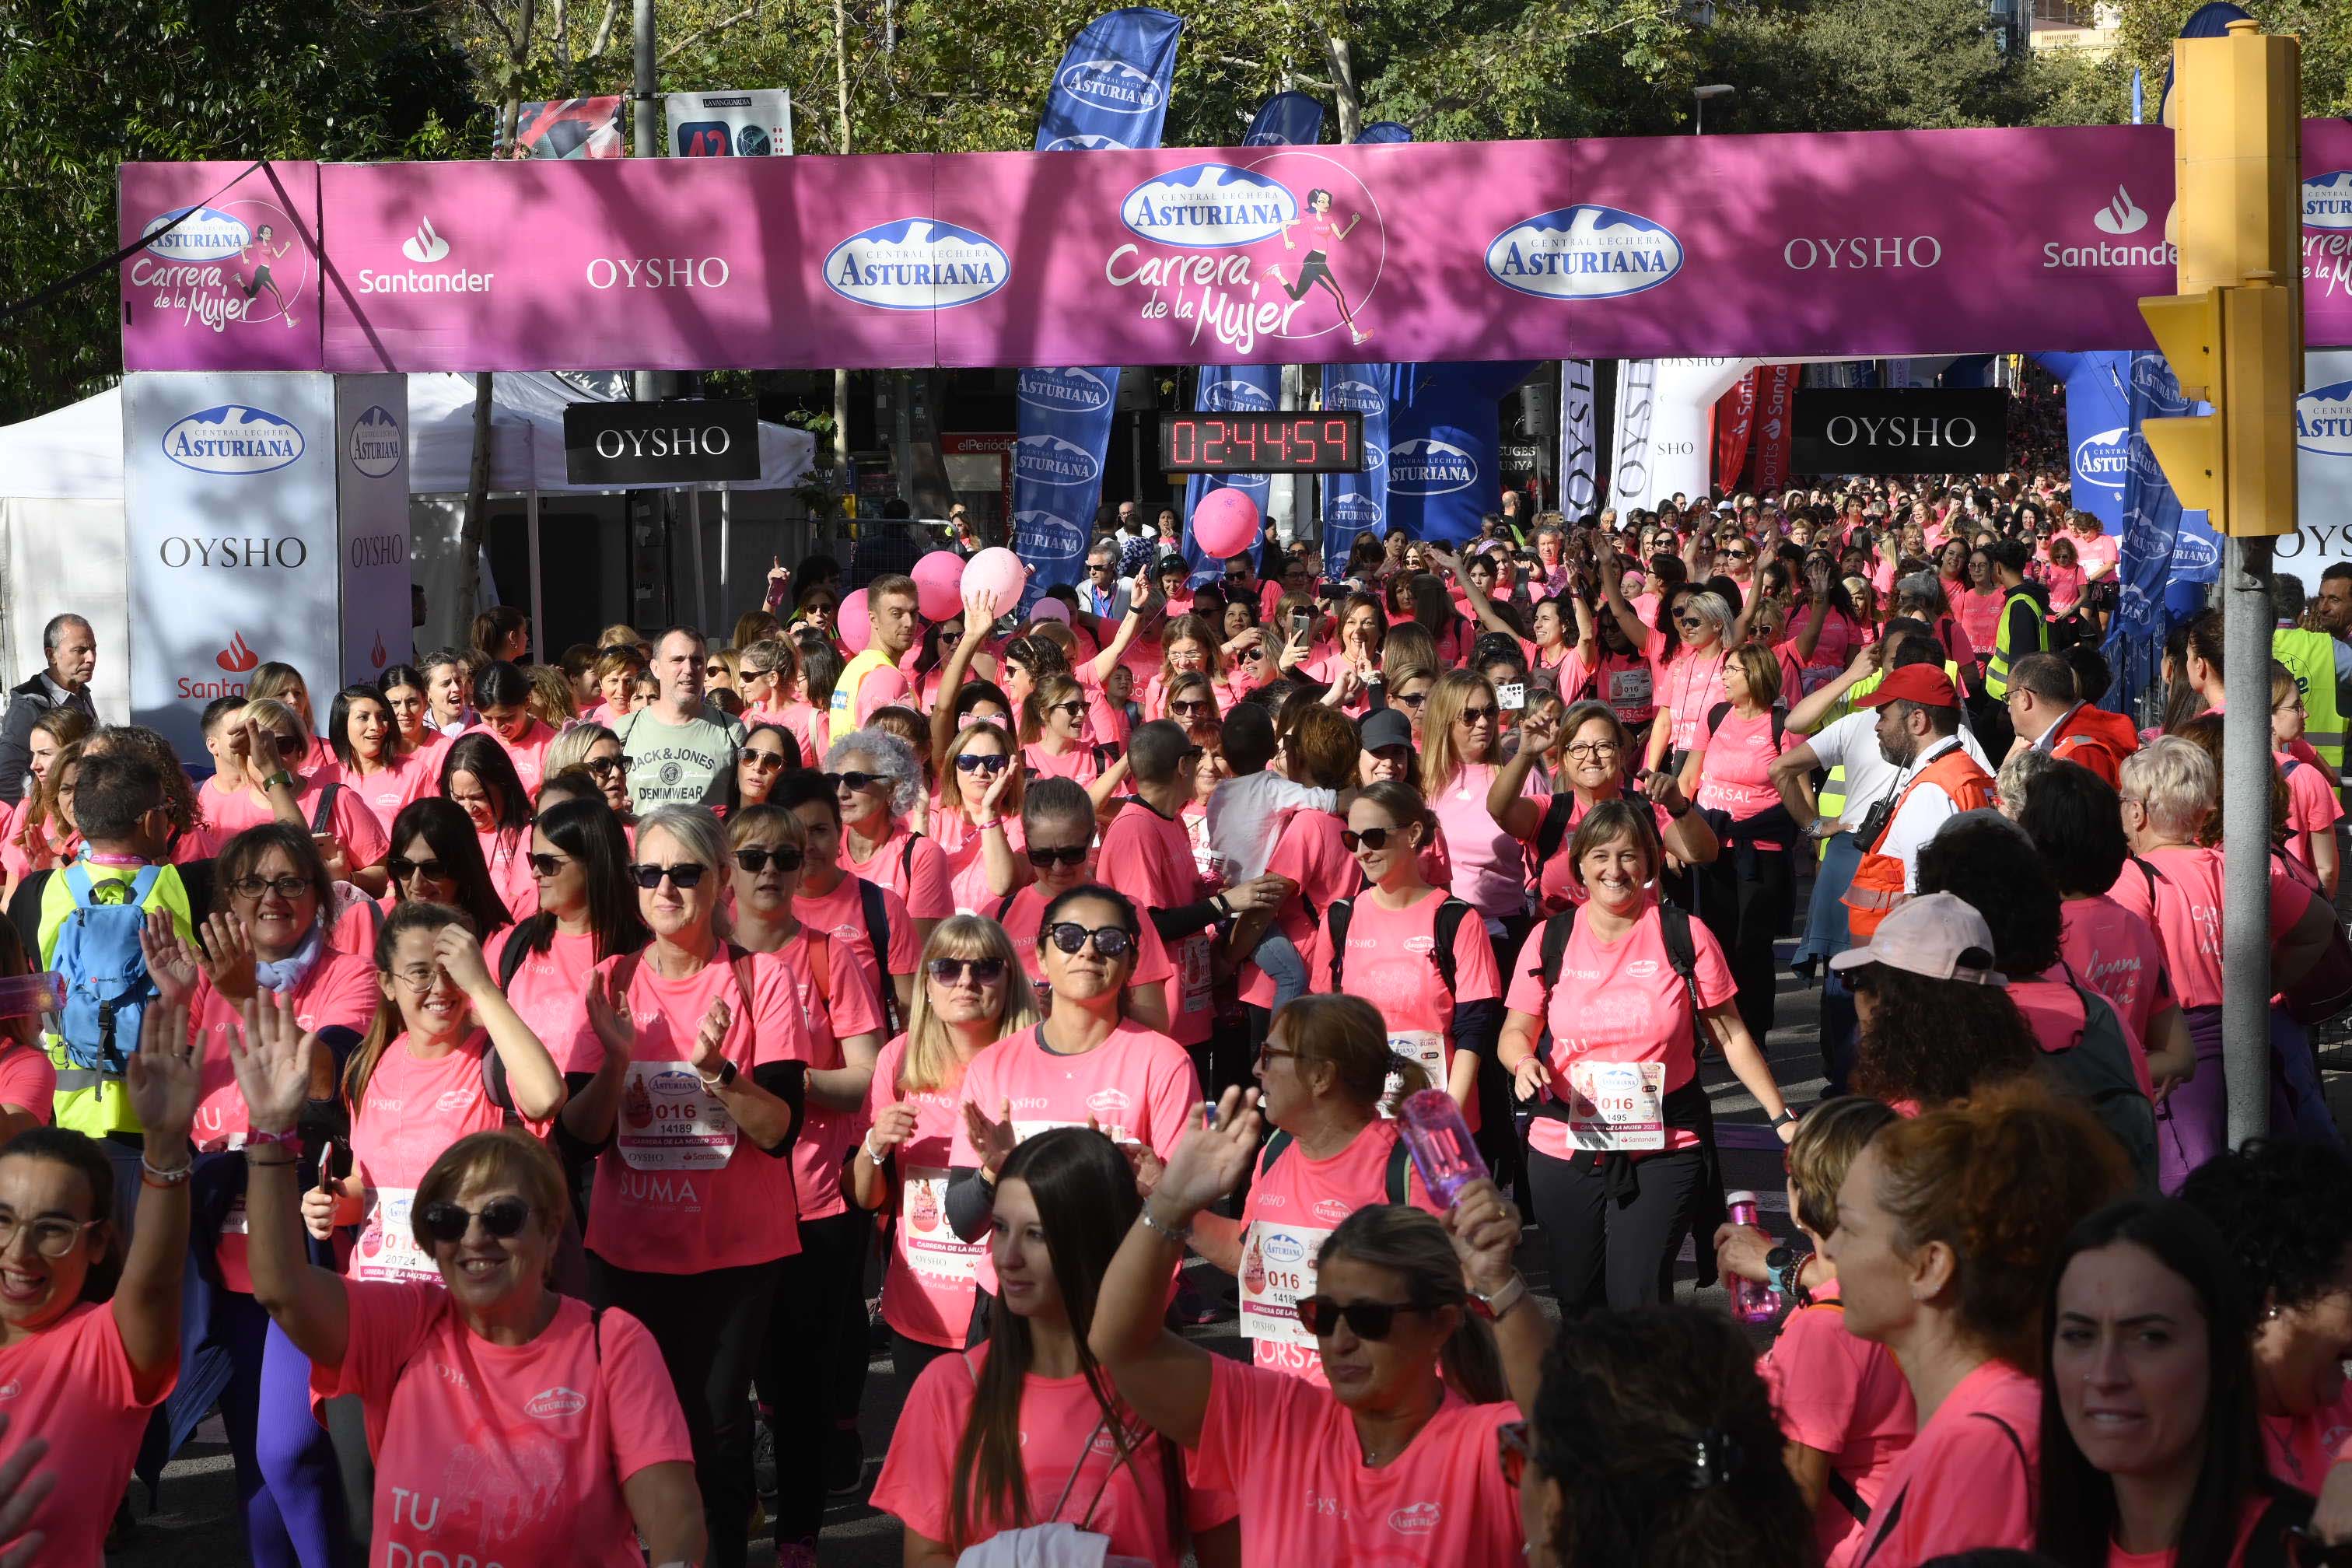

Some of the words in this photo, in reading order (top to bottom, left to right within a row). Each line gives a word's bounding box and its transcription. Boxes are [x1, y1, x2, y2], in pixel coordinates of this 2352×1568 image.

[1067, 71, 1153, 107] ASTURIANA
[1161, 192, 1218, 202] CENTRAL
[1223, 191, 1279, 201] LECHERA
[1134, 194, 1283, 227] ASTURIANA
[149, 226, 242, 247] ASTURIANA
[1531, 237, 1591, 248] CENTRAL
[1598, 236, 1662, 247] LECHERA
[866, 249, 924, 259] CENTRAL
[1501, 240, 1668, 277] ASTURIANA
[1784, 236, 1942, 271] OYSHO
[2043, 241, 2179, 268] Santande
[131, 257, 222, 287] Carrera
[586, 257, 729, 289] OYSHO
[838, 252, 996, 287] ASTURIANA
[1105, 243, 1251, 287] Carrera
[2315, 256, 2329, 278] la
[359, 268, 494, 293] Santander
[154, 289, 170, 308] de
[174, 289, 186, 309] la
[184, 285, 257, 333] Mujer
[1141, 291, 1169, 319] de
[1173, 291, 1194, 320] la
[1190, 276, 1306, 354] Mujer
[1018, 373, 1101, 405] ASTURIANA
[1767, 366, 1787, 415] Santa
[1827, 415, 1976, 448] OYSHO
[174, 431, 294, 457] ASTURIANA
[354, 440, 398, 460] ASTURIANA
[596, 425, 731, 460] OYSHO
[1173, 421, 1347, 464] 02:44:59
[1657, 441, 1695, 457] SHO
[1015, 454, 1090, 478] STURIANA
[1763, 443, 1779, 486] ports
[160, 537, 307, 569] OYSHO
[352, 534, 404, 569] OYSHO
[1016, 532, 1078, 553] TURIANA
[177, 677, 250, 699] Santa
[632, 748, 662, 772] JACK
[663, 748, 674, 760] &
[674, 747, 715, 770] JONES
[639, 786, 703, 801] DENIMWEAR
[1562, 886, 1587, 900] TU
[1562, 968, 1600, 979] OYSHO
[1558, 1038, 1589, 1056] TU
[652, 1080, 698, 1090] ASTURIANA
[1601, 1076, 1637, 1087] ASTURIANA
[656, 1104, 697, 1119] 016
[1601, 1097, 1633, 1111] 016
[1607, 1113, 1627, 1122] 1495
[660, 1124, 692, 1133] 14189
[1576, 1136, 1606, 1145] OYSHO
[1628, 1136, 1658, 1144] Santander
[628, 1153, 663, 1163] OYSHO
[621, 1172, 698, 1203] SUMA
[916, 1241, 947, 1252] CARRERA
[1266, 1243, 1300, 1258] ASTURIANA
[385, 1255, 416, 1266] 20724
[915, 1255, 947, 1267] OYSHO
[407, 1272, 432, 1281] MUJER
[1269, 1270, 1300, 1290] 016
[1252, 1306, 1276, 1315] CARRERA
[1252, 1320, 1276, 1333] OYSHO
[530, 1398, 583, 1414] ASTURIANA
[391, 1486, 440, 1531] TU
